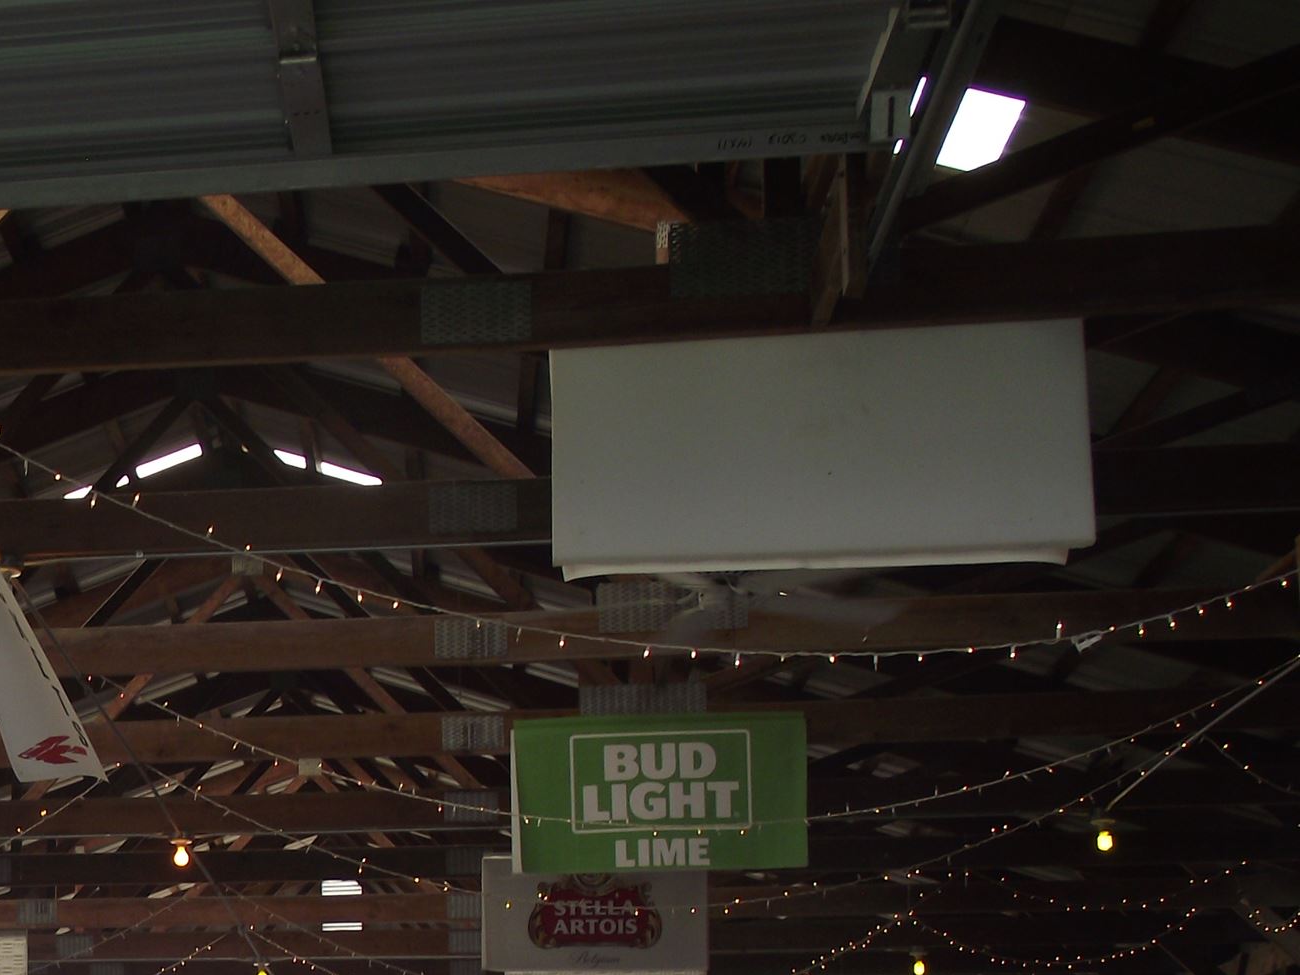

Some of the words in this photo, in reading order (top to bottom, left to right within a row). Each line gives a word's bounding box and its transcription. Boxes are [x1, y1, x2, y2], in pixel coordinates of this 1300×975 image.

[603, 741, 717, 782] BUD
[582, 780, 740, 823] LIGHT
[614, 837, 711, 868] LIME
[553, 899, 636, 917] STELLA
[552, 918, 639, 936] ARTOIS
